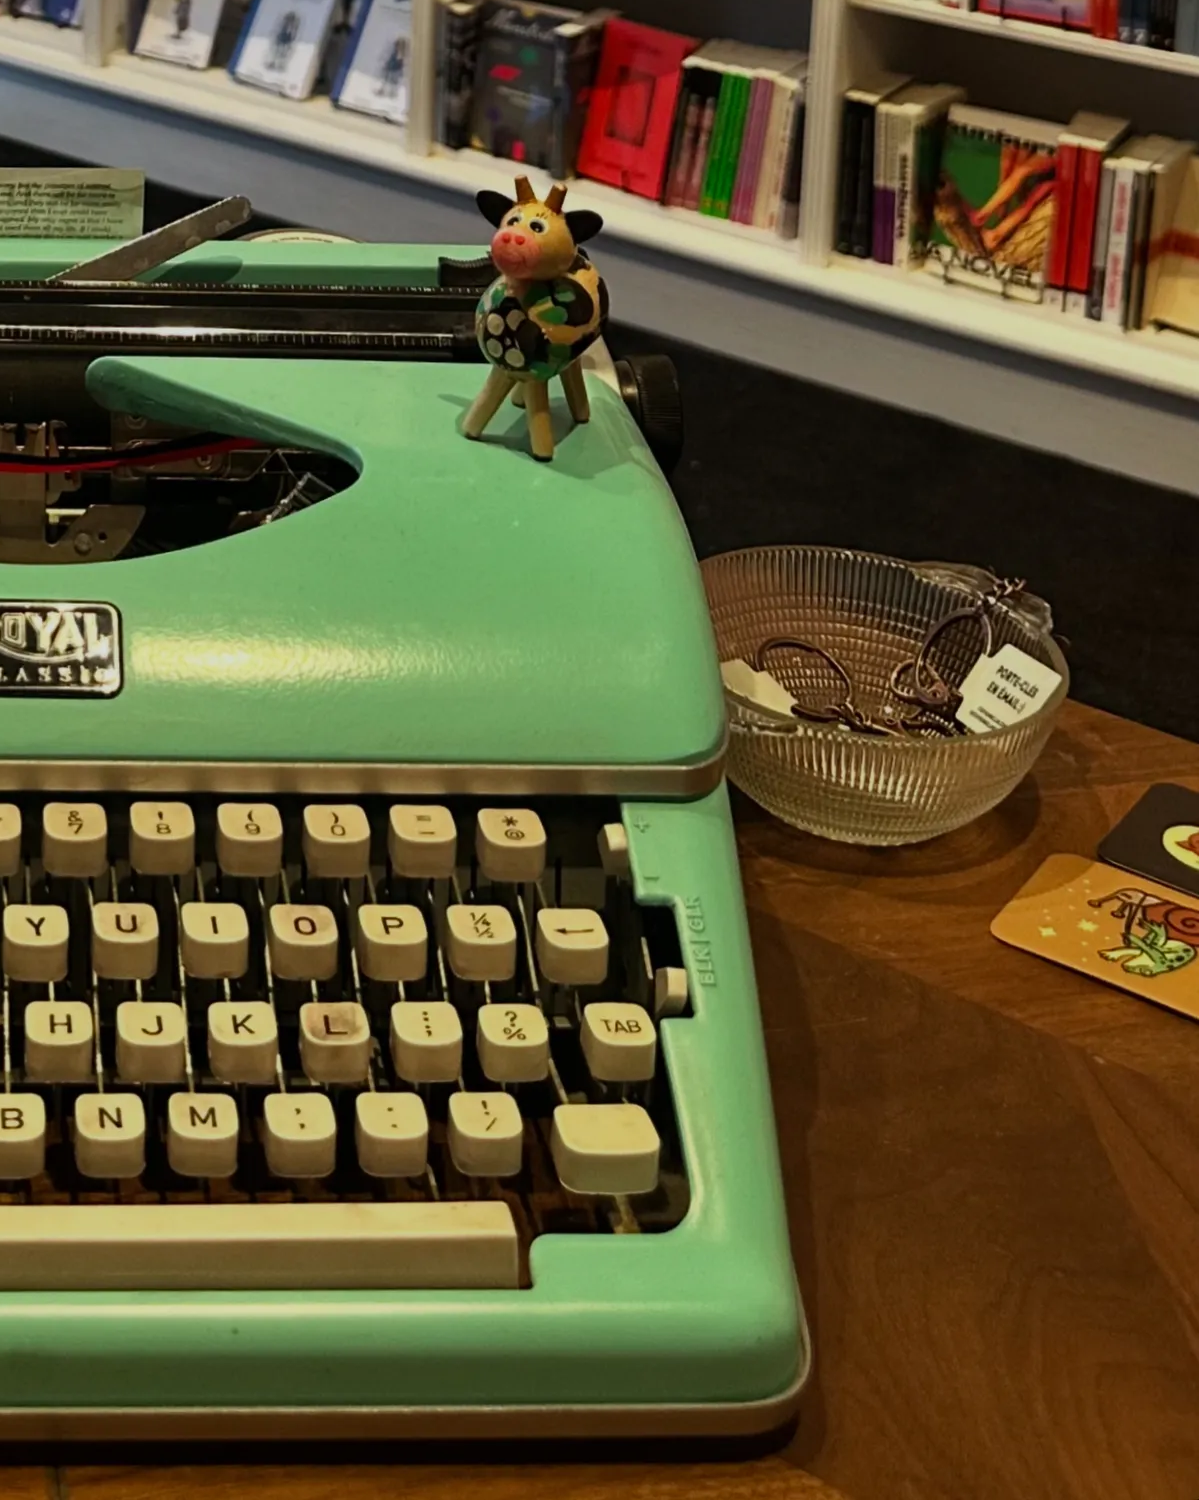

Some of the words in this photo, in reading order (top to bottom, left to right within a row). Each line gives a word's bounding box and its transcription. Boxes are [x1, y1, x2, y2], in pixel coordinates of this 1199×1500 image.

[949, 251, 1043, 290] NOVEL
[69, 822, 84, 835] 7
[155, 823, 172, 835] 8
[244, 823, 261, 835] 9
[330, 823, 346, 837] 0
[25, 917, 46, 937] Y
[115, 914, 138, 934] U
[210, 915, 219, 935] I
[381, 916, 404, 935] P
[49, 1013, 73, 1034] H
[141, 1015, 164, 1036] J
[231, 1014, 255, 1035] K
[323, 1014, 348, 1036] L
[602, 1019, 642, 1034] TAB
[0, 1107, 25, 1130] B
[98, 1107, 123, 1129] N
[189, 1106, 218, 1128] M
